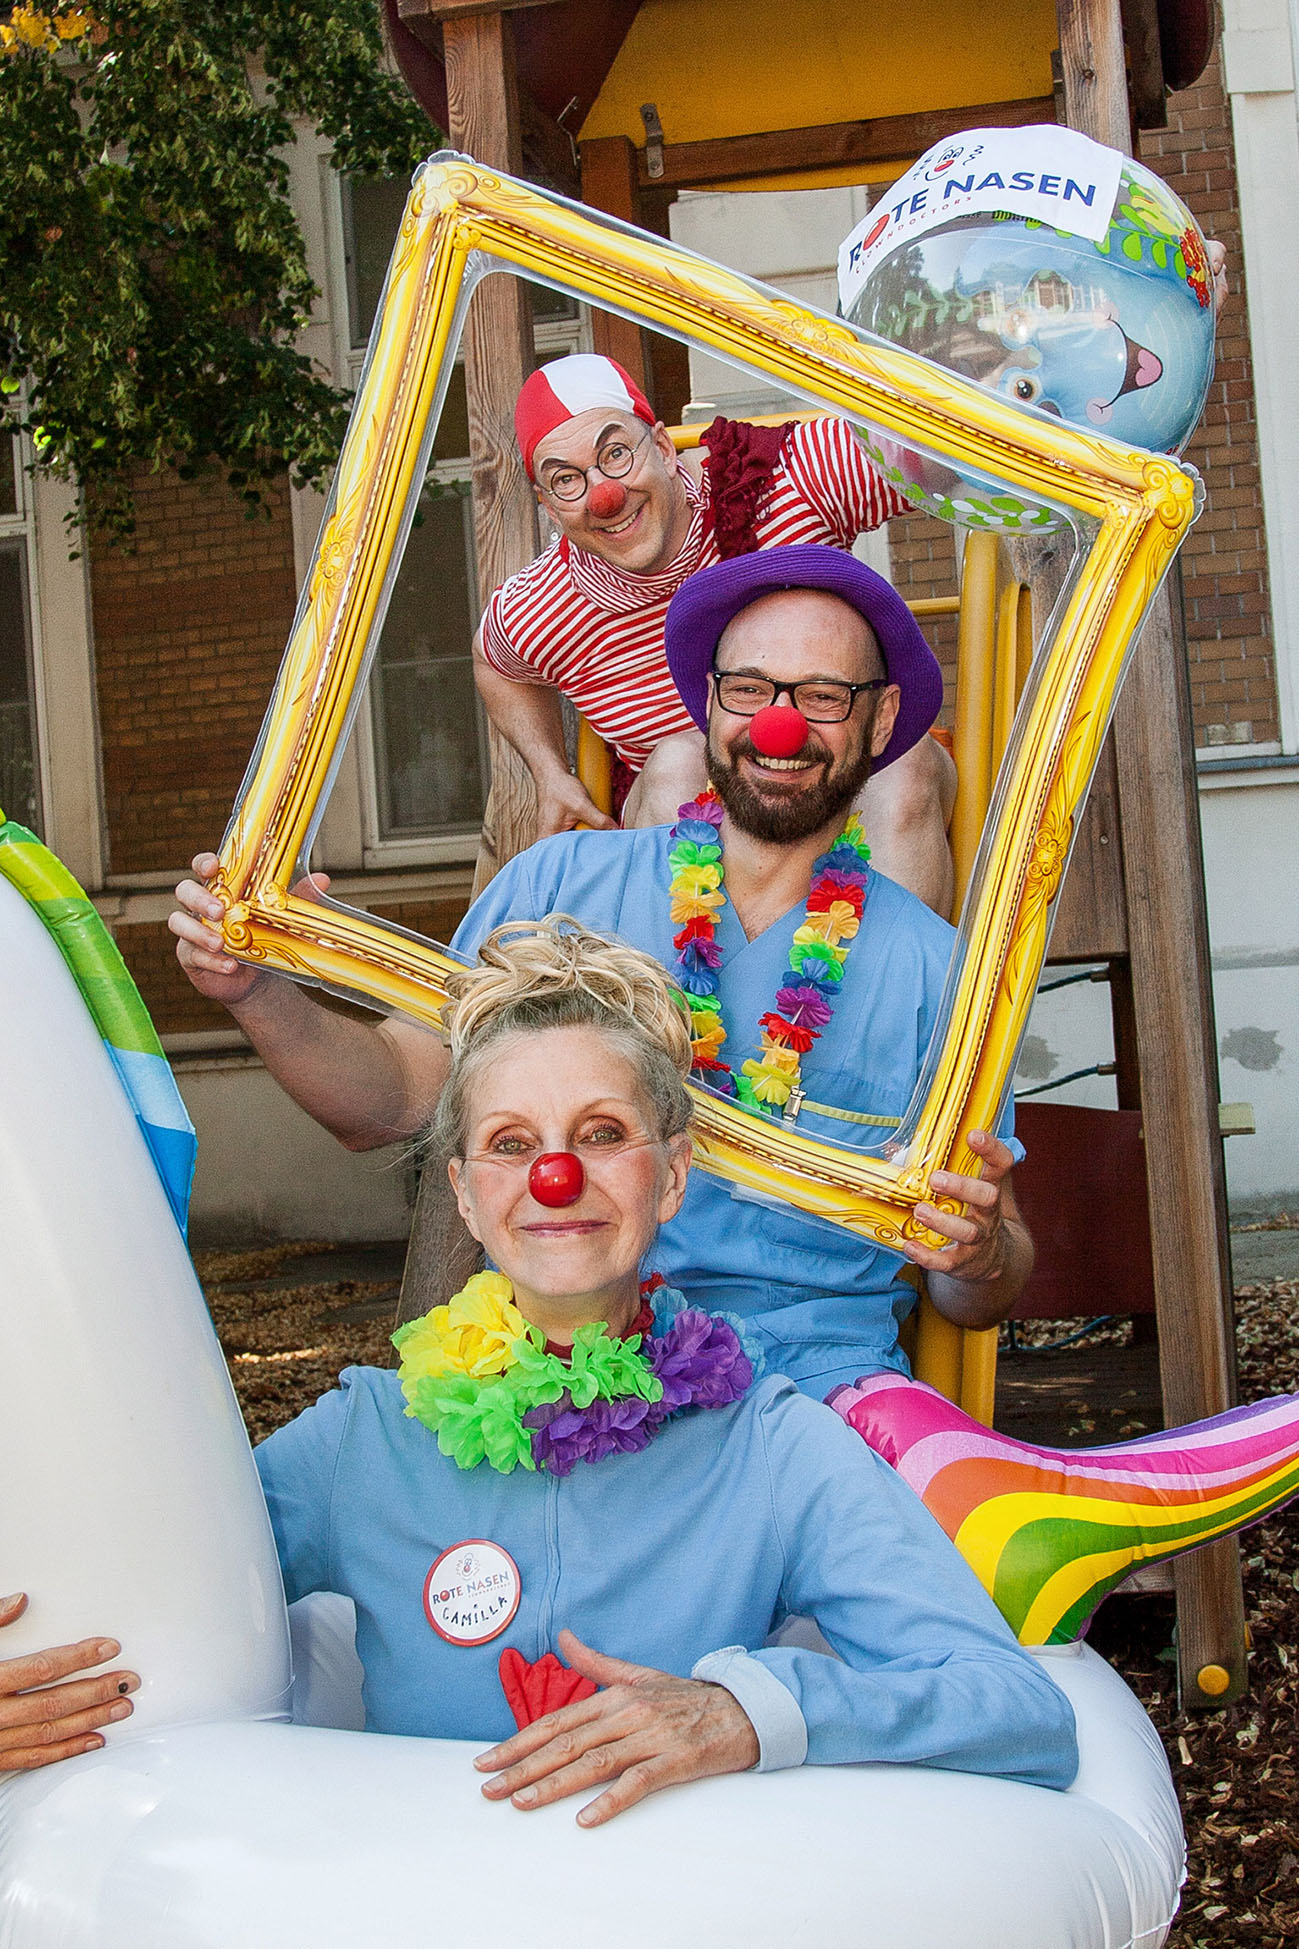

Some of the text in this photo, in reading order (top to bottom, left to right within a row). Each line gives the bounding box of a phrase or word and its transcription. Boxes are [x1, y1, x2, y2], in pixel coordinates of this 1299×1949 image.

[849, 171, 1097, 273] ROTE NASEN
[432, 1586, 463, 1605] ROTE
[467, 1571, 509, 1593] NASEN
